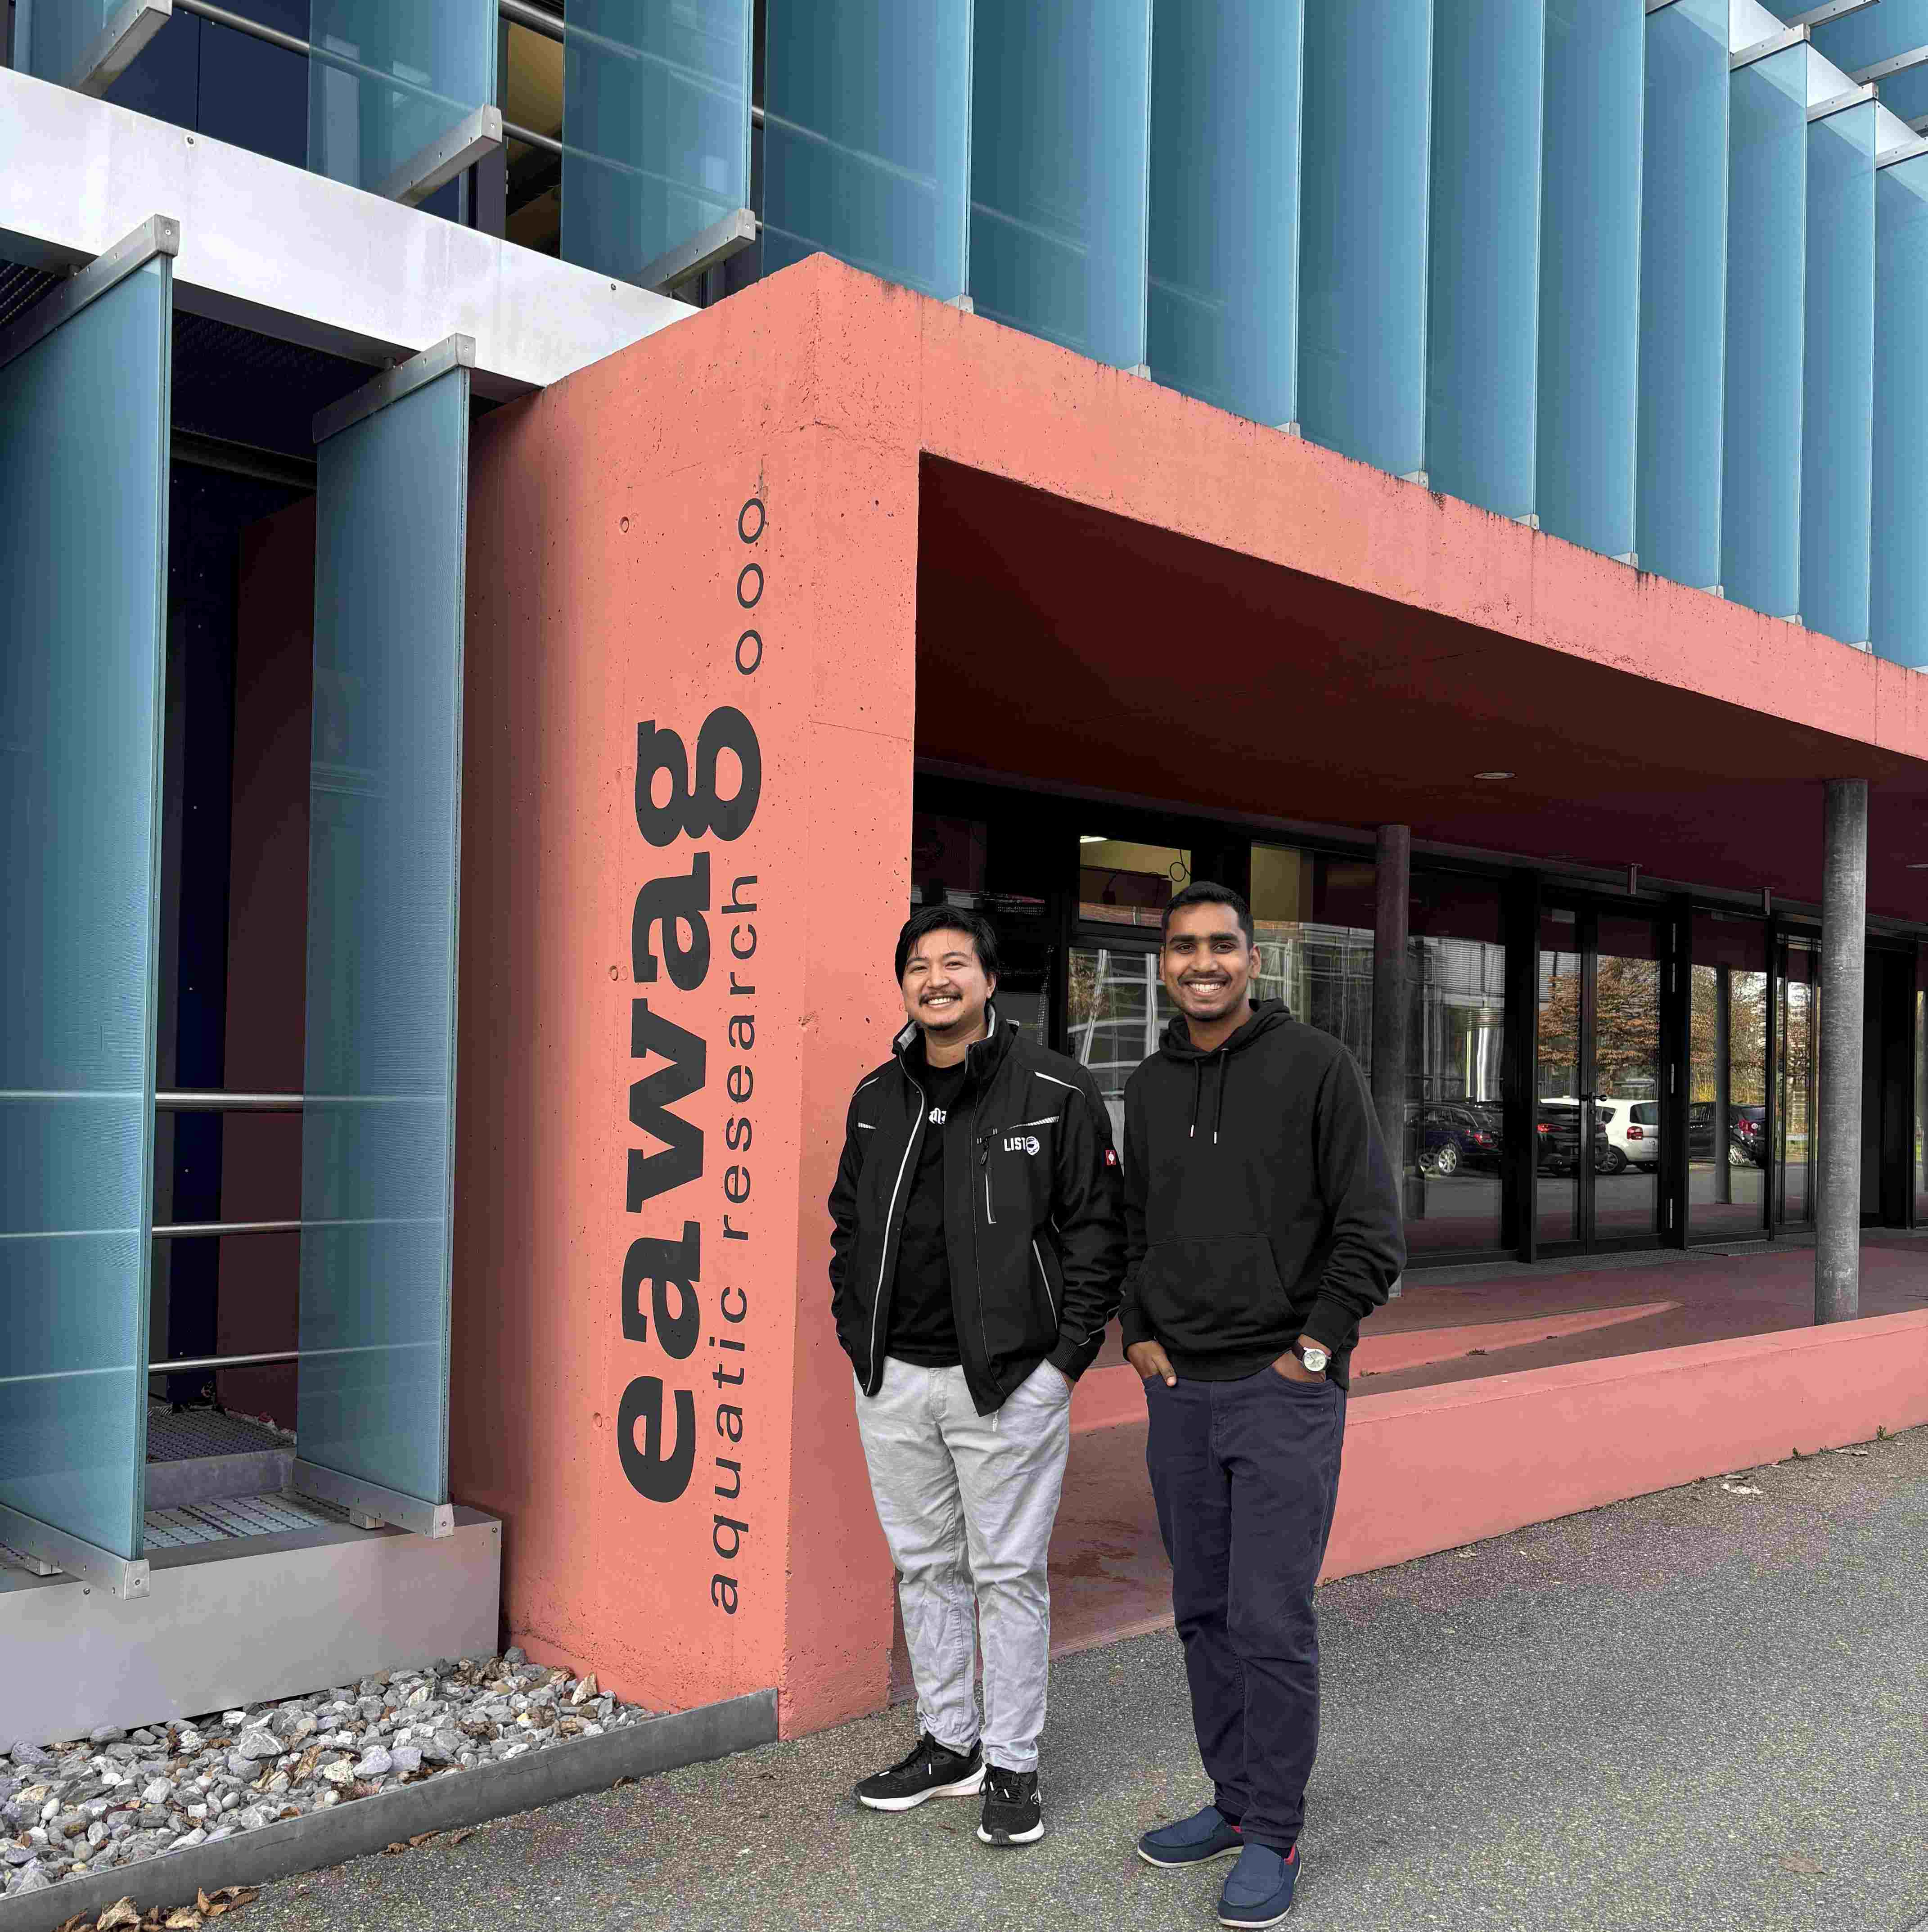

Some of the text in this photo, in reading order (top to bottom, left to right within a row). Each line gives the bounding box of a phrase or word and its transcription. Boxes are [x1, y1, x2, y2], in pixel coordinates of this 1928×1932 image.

[617, 706, 761, 1503] eawag
[721, 876, 757, 1240] research
[709, 1287, 748, 1615] aquatic
